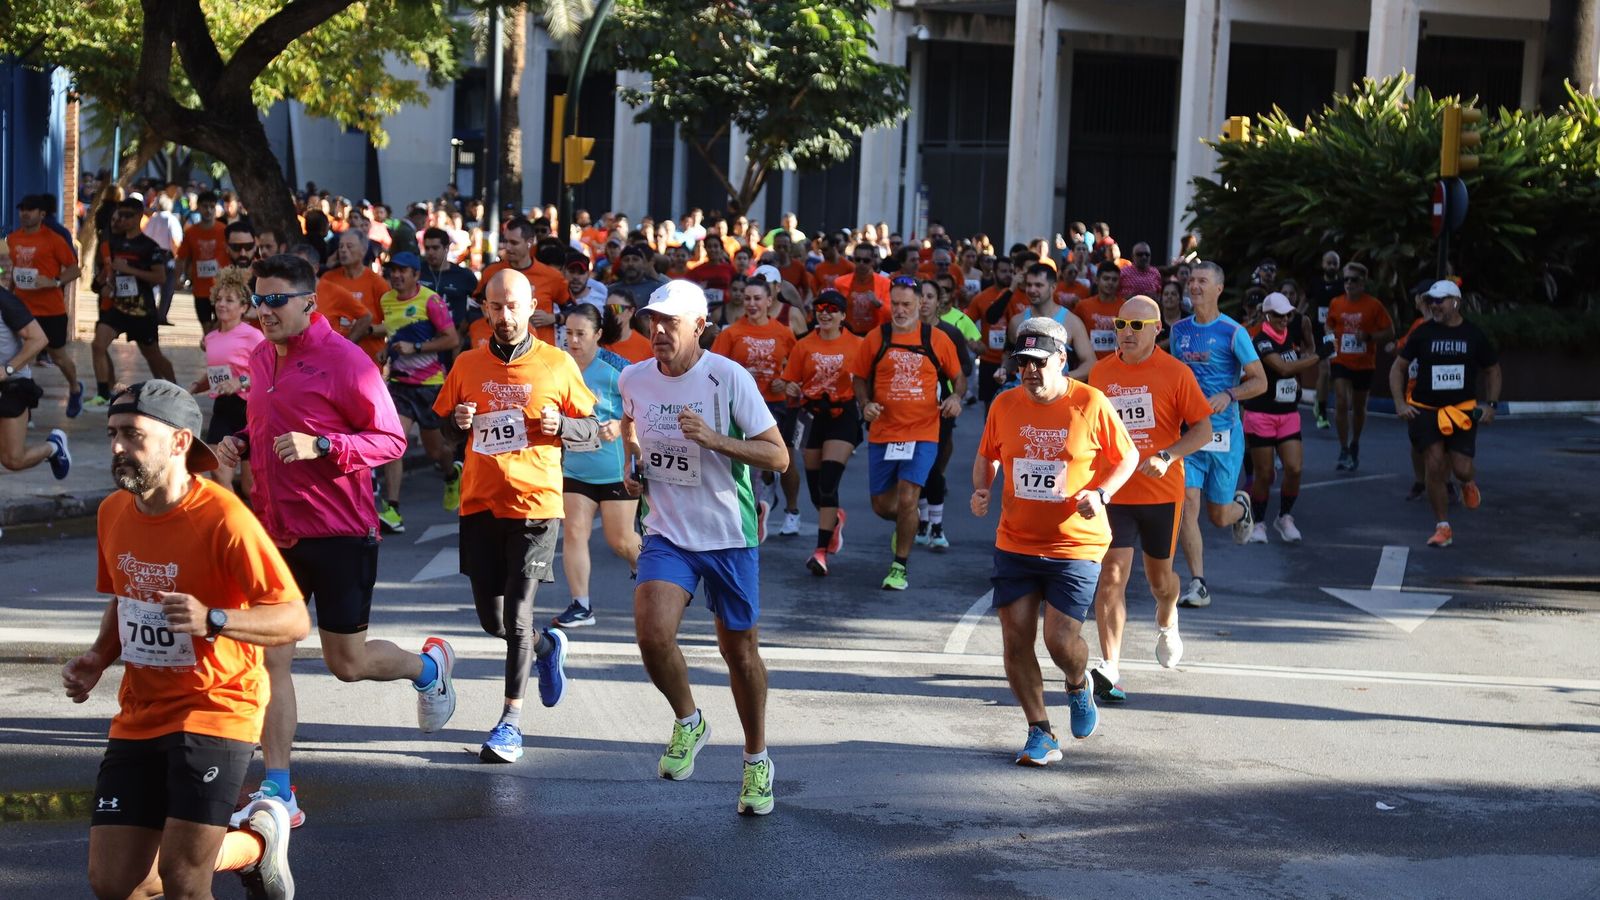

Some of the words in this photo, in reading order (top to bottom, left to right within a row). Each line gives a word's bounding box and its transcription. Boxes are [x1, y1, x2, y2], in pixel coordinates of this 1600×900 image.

[1431, 340, 1467, 354] FITCLUB
[1436, 373, 1462, 382] 1086
[480, 425, 515, 443] 719
[650, 452, 689, 472] 975
[1020, 474, 1056, 489] 176
[125, 558, 167, 576] Carrera
[127, 621, 175, 647] 700
